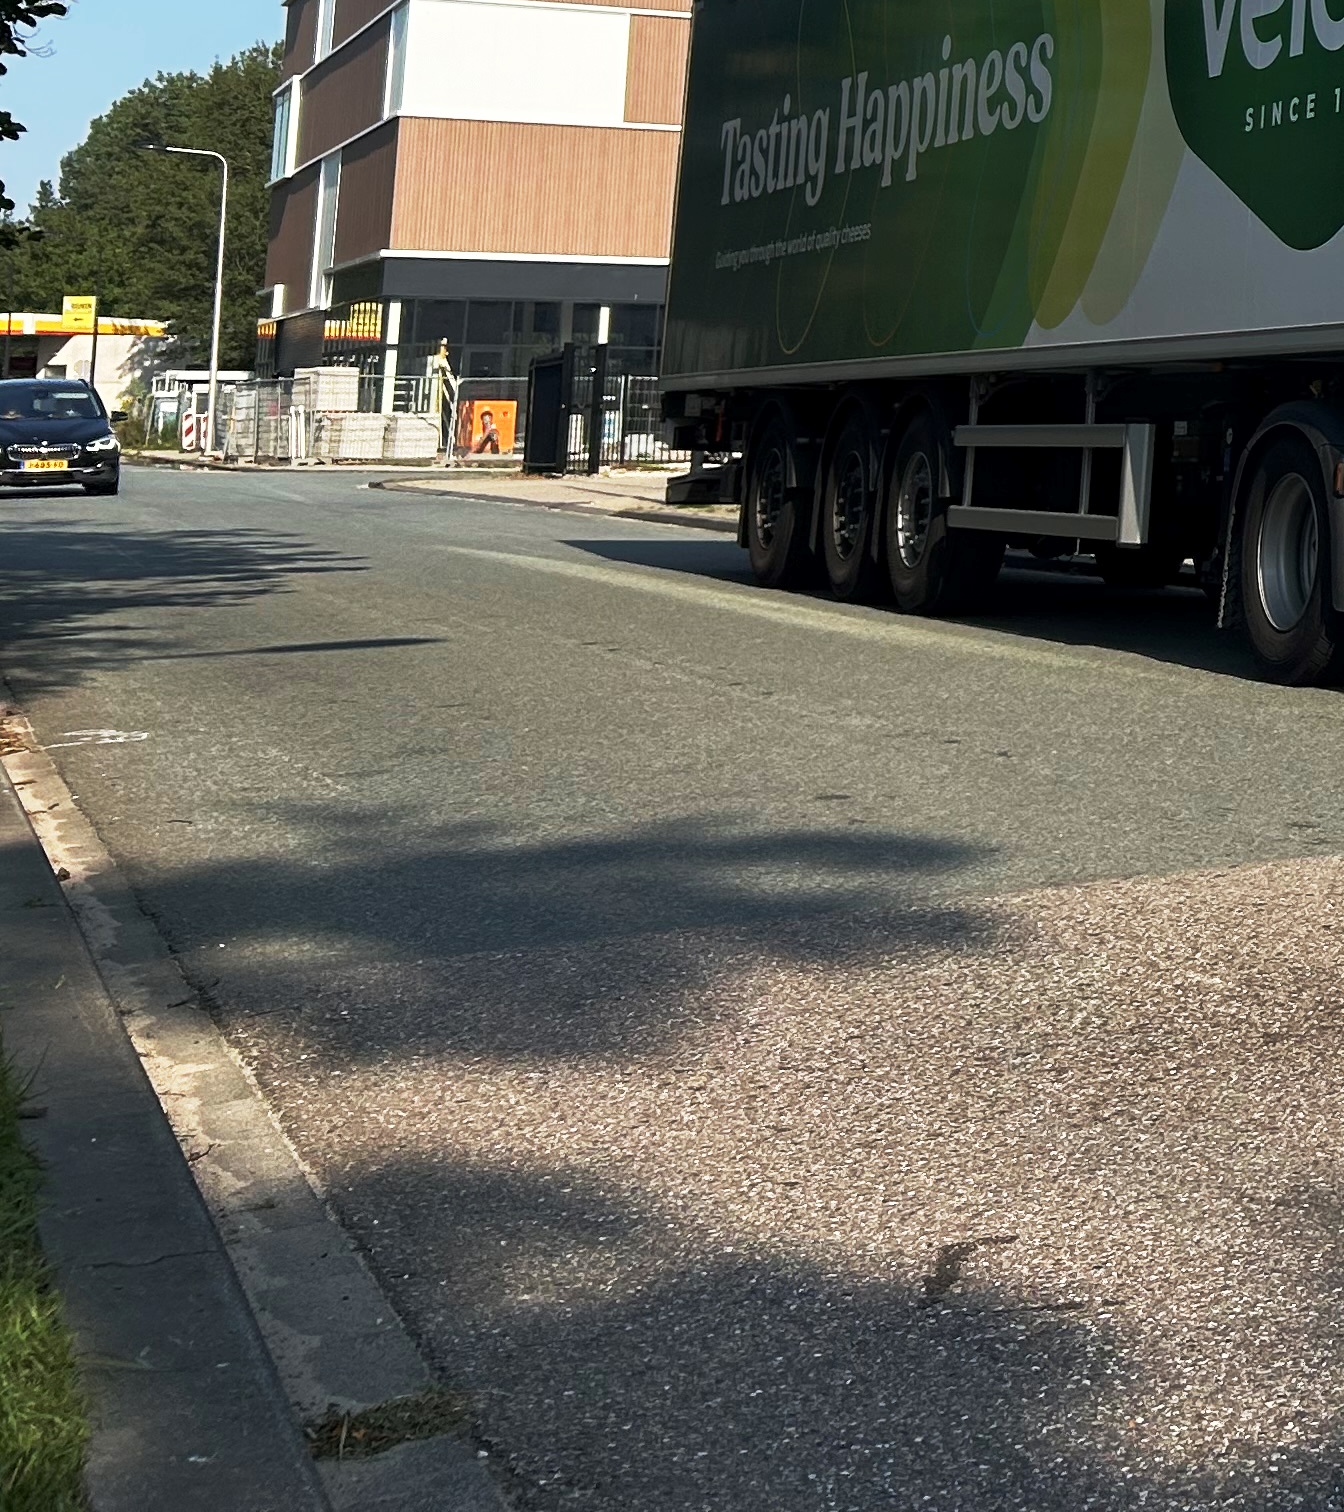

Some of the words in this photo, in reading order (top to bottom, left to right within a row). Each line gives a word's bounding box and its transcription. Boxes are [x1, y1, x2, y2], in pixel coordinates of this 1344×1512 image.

[721, 93, 829, 206] Tasting
[835, 33, 1054, 187] Happiness
[1245, 92, 1316, 132] SINCE
[776, 239, 787, 257] the
[787, 232, 806, 254] world
[807, 230, 816, 251] of
[816, 226, 840, 254] quality
[841, 223, 872, 244] cheeses
